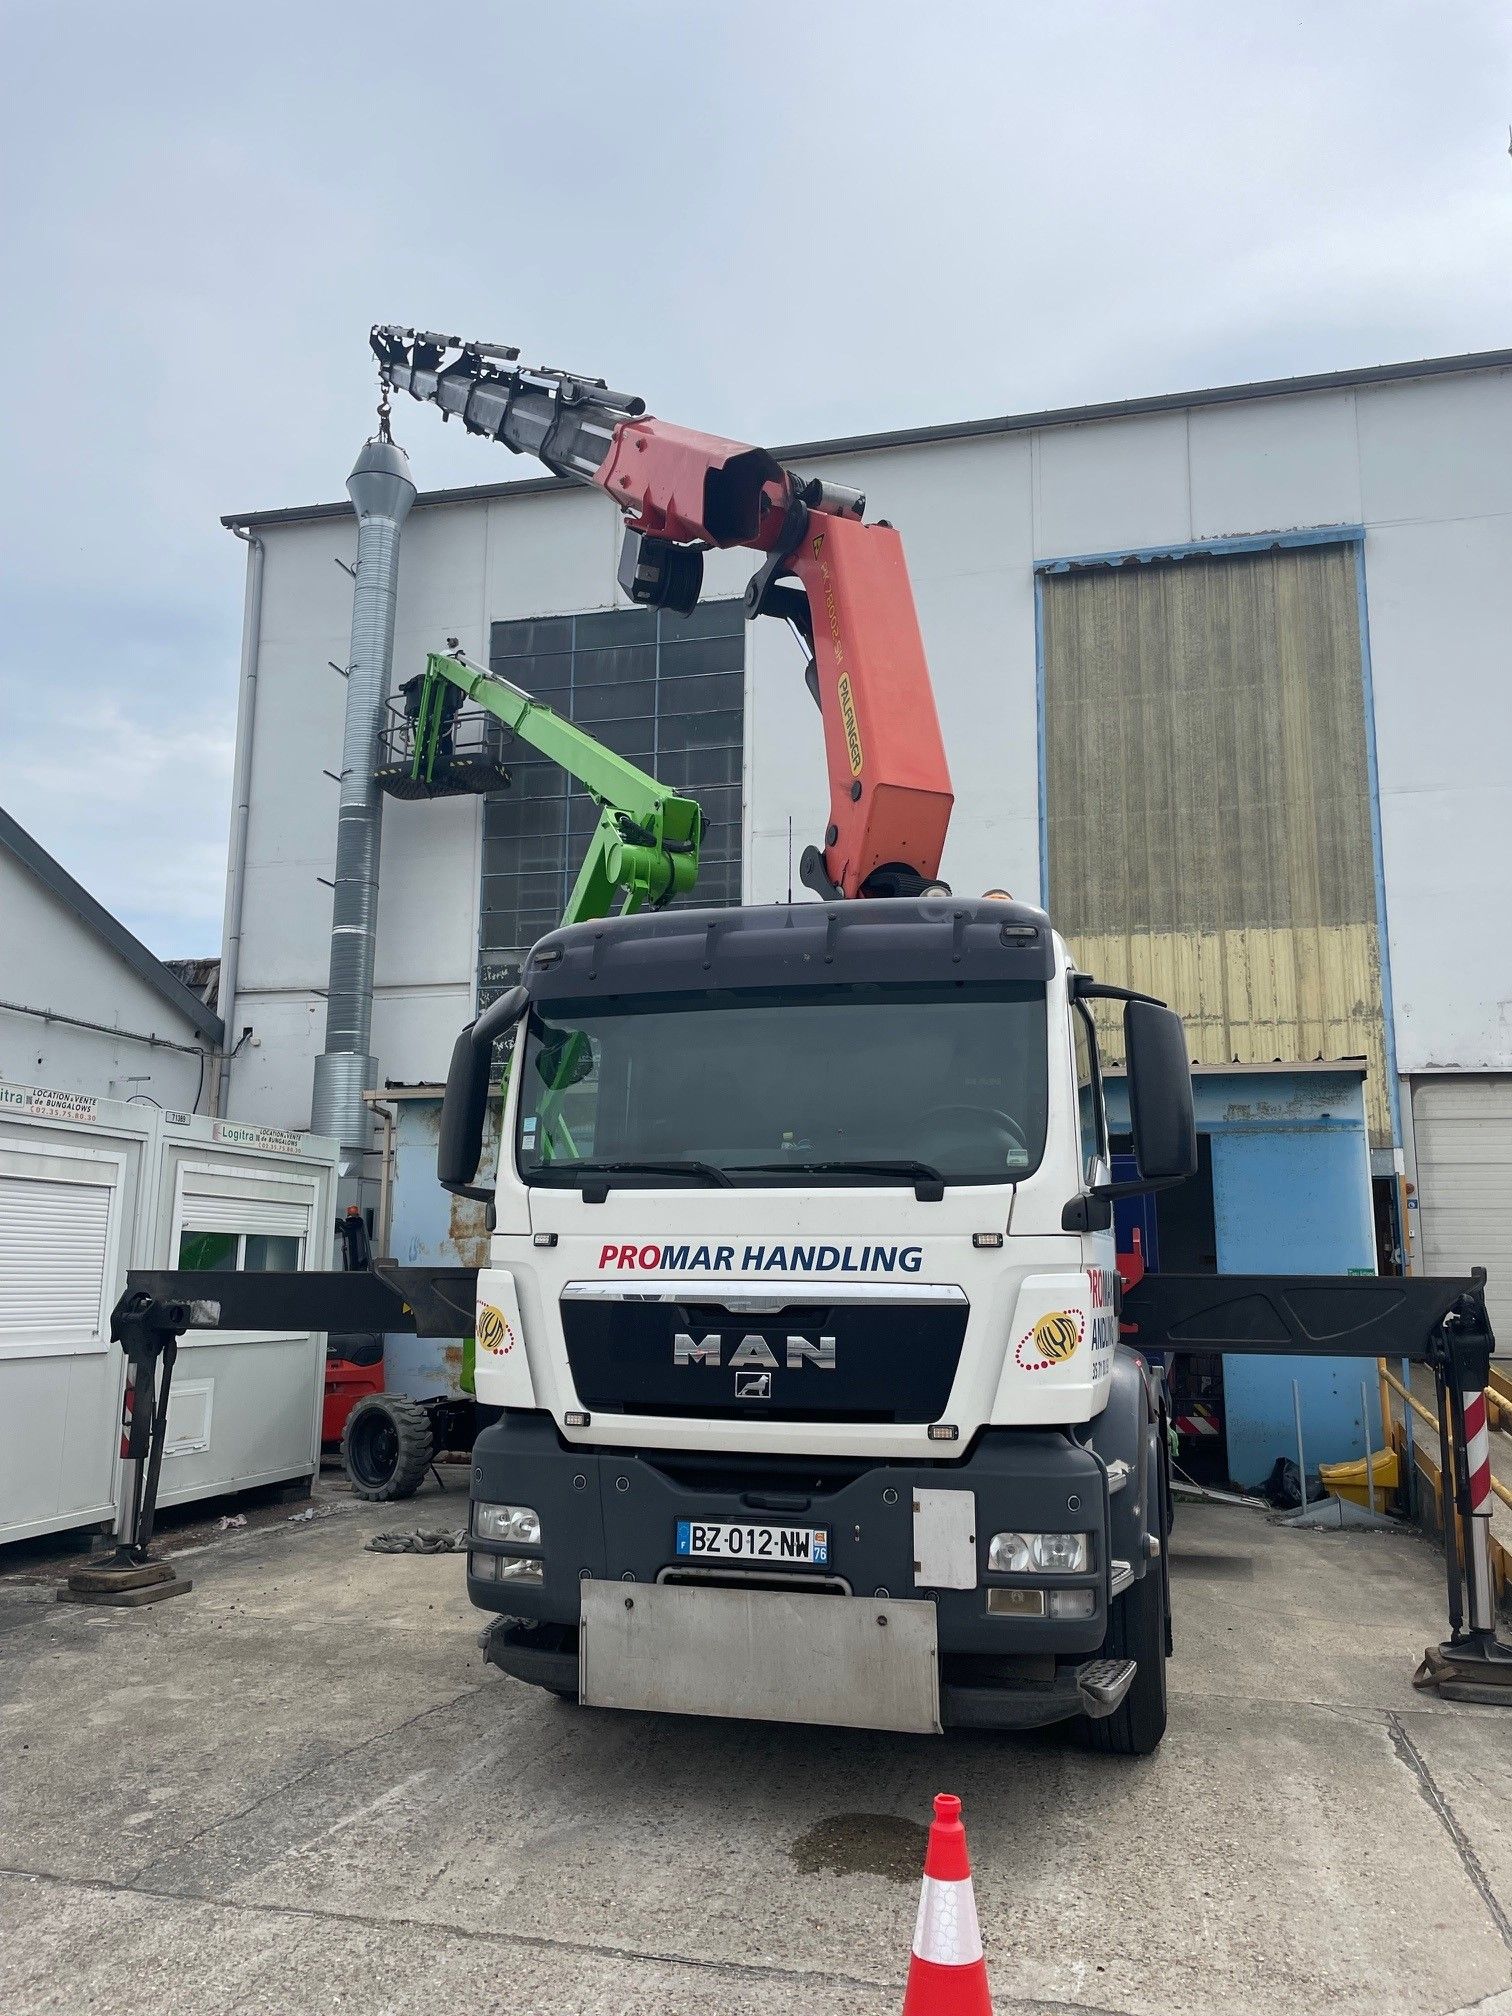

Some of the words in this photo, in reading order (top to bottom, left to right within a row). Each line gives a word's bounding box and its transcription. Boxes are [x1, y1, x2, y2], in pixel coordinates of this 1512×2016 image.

[839, 677, 861, 772] PALFINGER
[33, 1089, 70, 1102] LOCATION
[74, 1096, 96, 1106] VENTE
[46, 1099, 91, 1113] BUNGALOWS
[222, 1126, 254, 1142] Logitra
[260, 1129, 284, 1138] LOCATION
[269, 1136, 298, 1147] BUNGALOWS
[599, 1245, 735, 1271] PROMAR
[741, 1245, 923, 1272] HANDLING
[673, 1333, 836, 1369] MAN
[814, 1547, 827, 1560] 76
